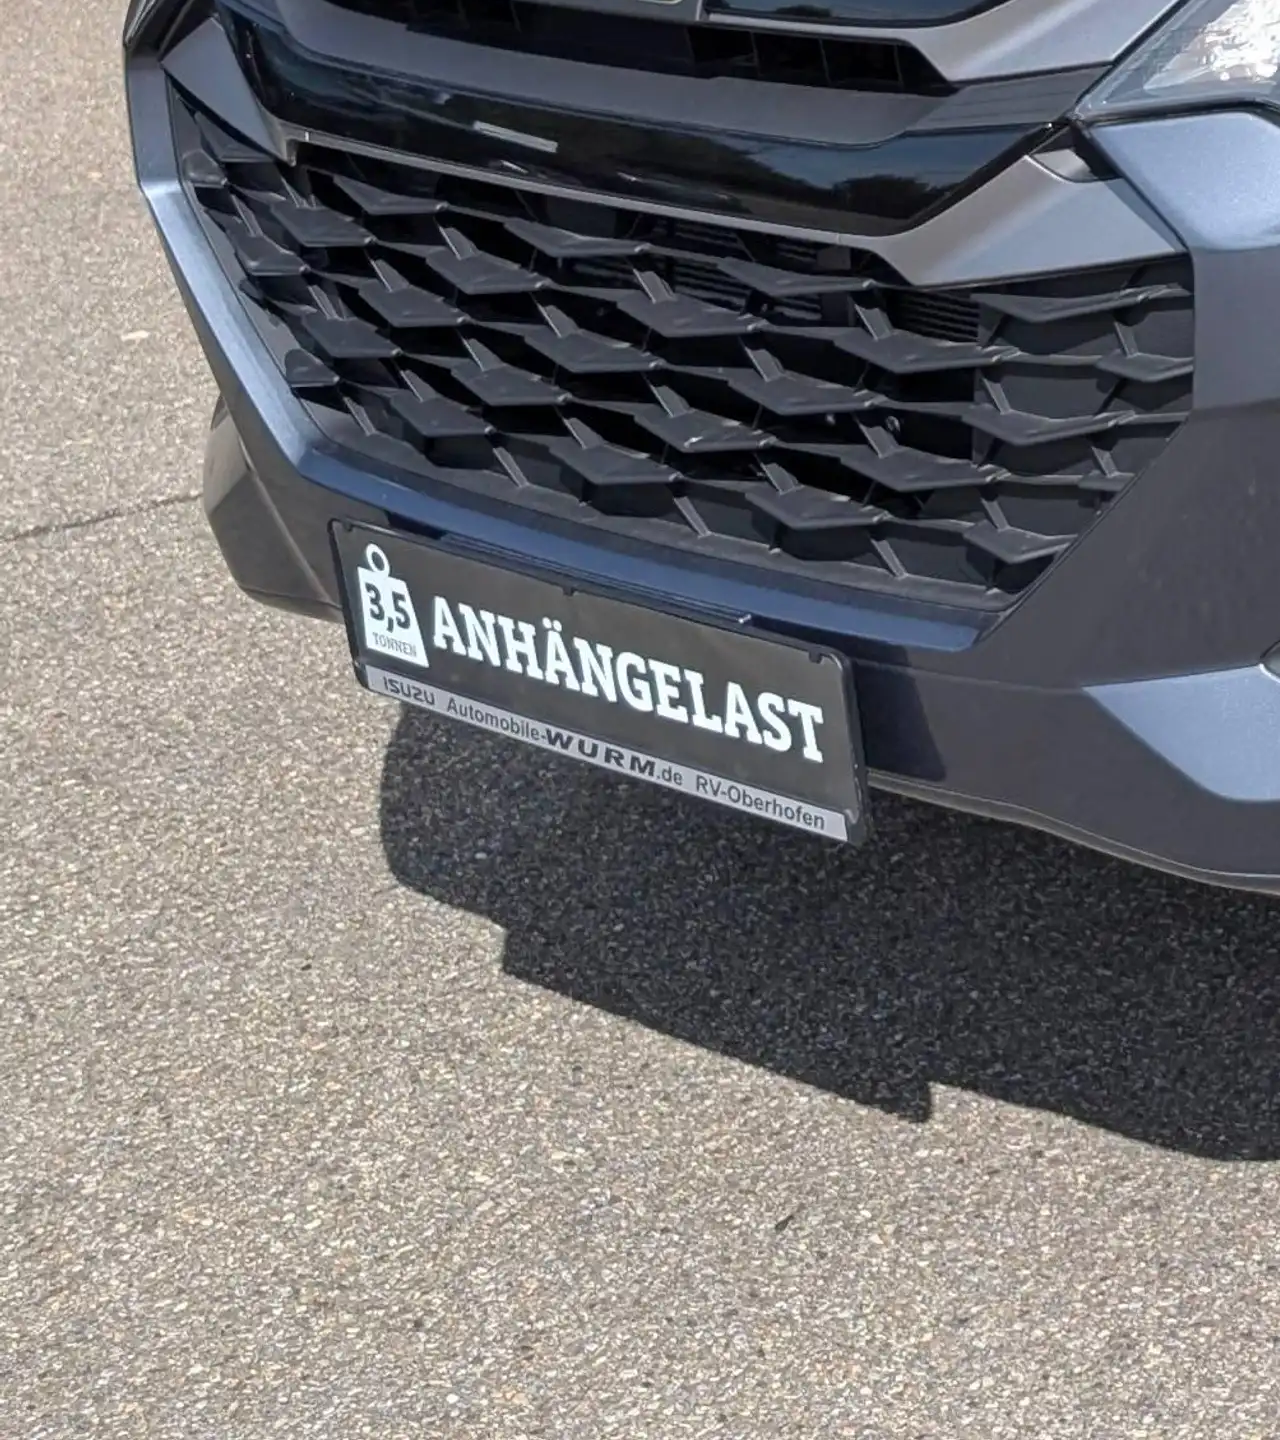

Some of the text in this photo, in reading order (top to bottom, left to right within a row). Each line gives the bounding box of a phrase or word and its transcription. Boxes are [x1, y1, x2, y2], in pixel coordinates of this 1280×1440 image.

[364, 581, 411, 634] 3,5
[372, 631, 417, 658] TONNEN
[432, 595, 824, 764] ANHÄNGELAST
[382, 675, 826, 831] ISUZU Automobile-WURM.de RV-Oberhofen
